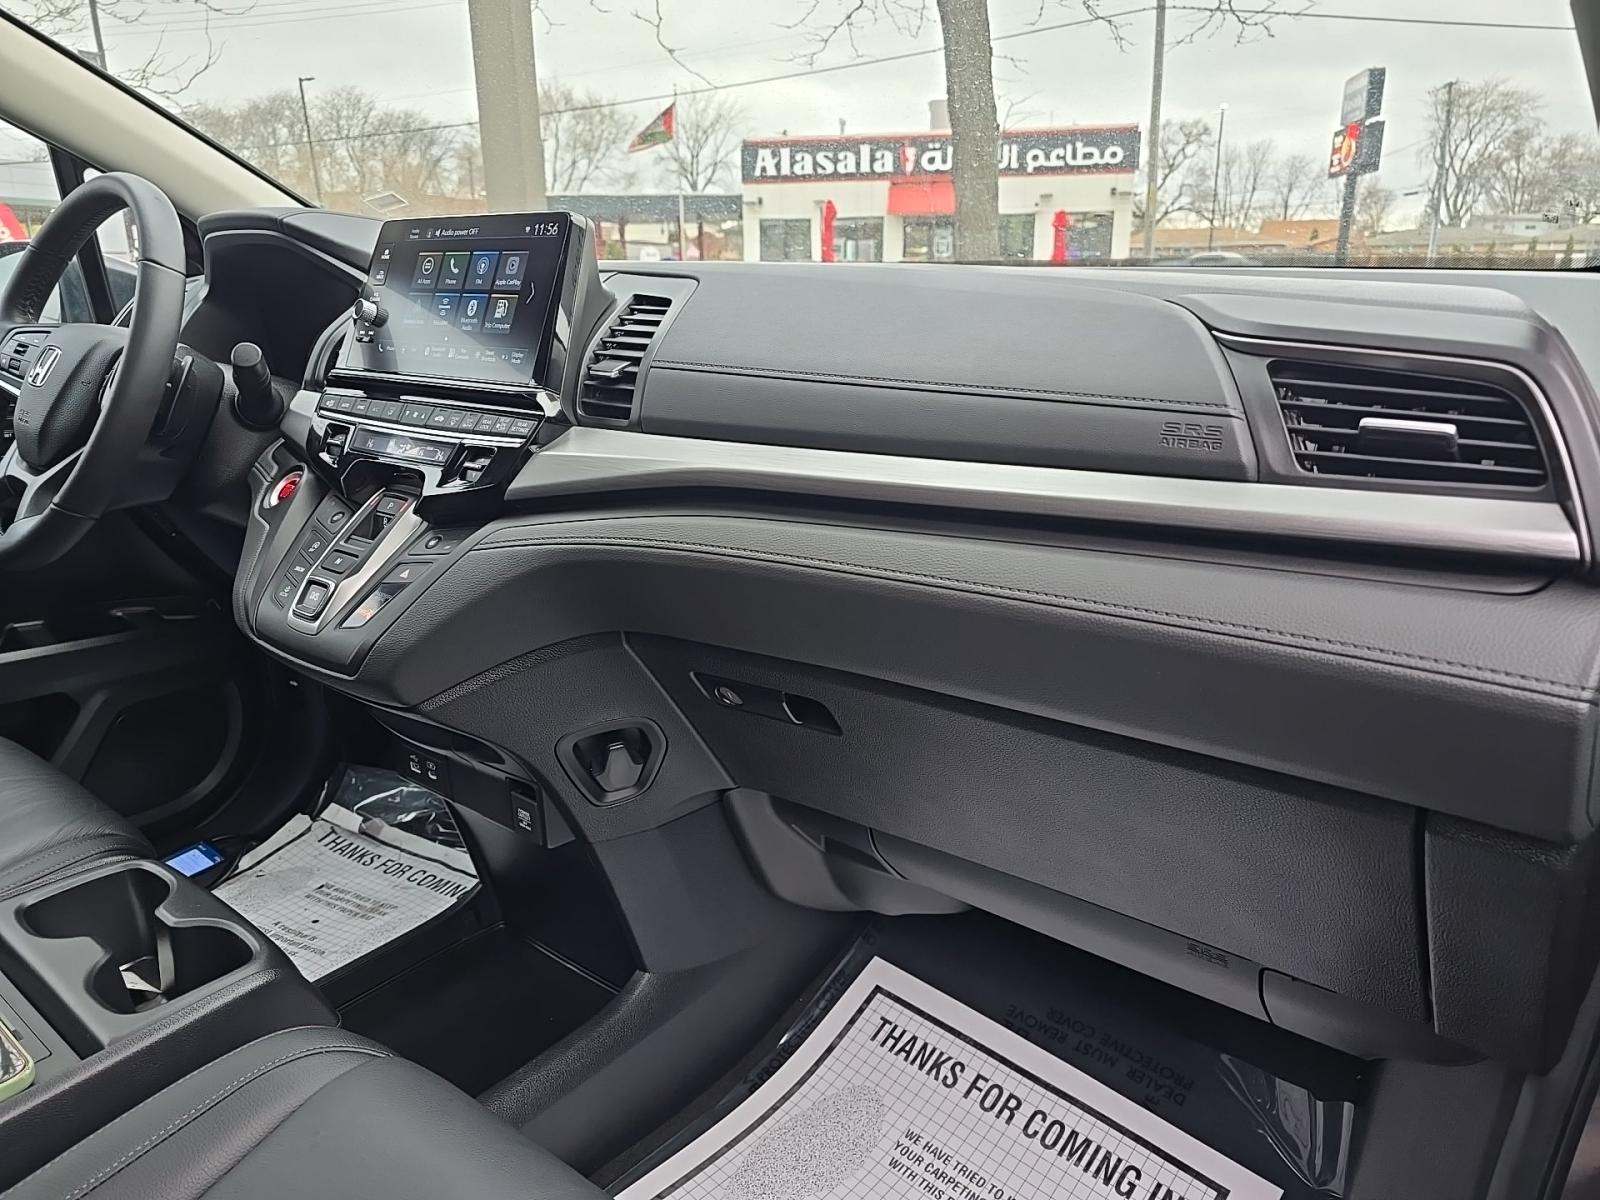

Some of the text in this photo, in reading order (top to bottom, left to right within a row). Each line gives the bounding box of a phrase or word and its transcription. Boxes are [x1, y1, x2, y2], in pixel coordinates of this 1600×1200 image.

[754, 143, 893, 177] Alasala
[1026, 144, 1125, 174] مطاعم
[469, 228, 480, 236] OFF
[534, 222, 559, 236] 11:56
[491, 322, 511, 330] Computer
[1159, 437, 1223, 451] AIRBAG
[1161, 421, 1223, 438] SRS
[387, 502, 395, 510] P
[316, 825, 468, 899] THANKS FOR COMIN
[1004, 1004, 1069, 1044] REMOVE
[1046, 1006, 1096, 1039] COVER
[1073, 1039, 1119, 1068] MUST
[1099, 1033, 1194, 1091] PROTECTIVE
[1126, 1065, 1187, 1107] DEALER
[869, 1016, 966, 1089] THANKS
[962, 1073, 1023, 1126] FOR
[1022, 1109, 1142, 1200] COMING
[893, 1139, 925, 1167] YOUR
[904, 1128, 1005, 1200] WE HAVE TRIED TO
[888, 1156, 945, 1200] WITH THIS
